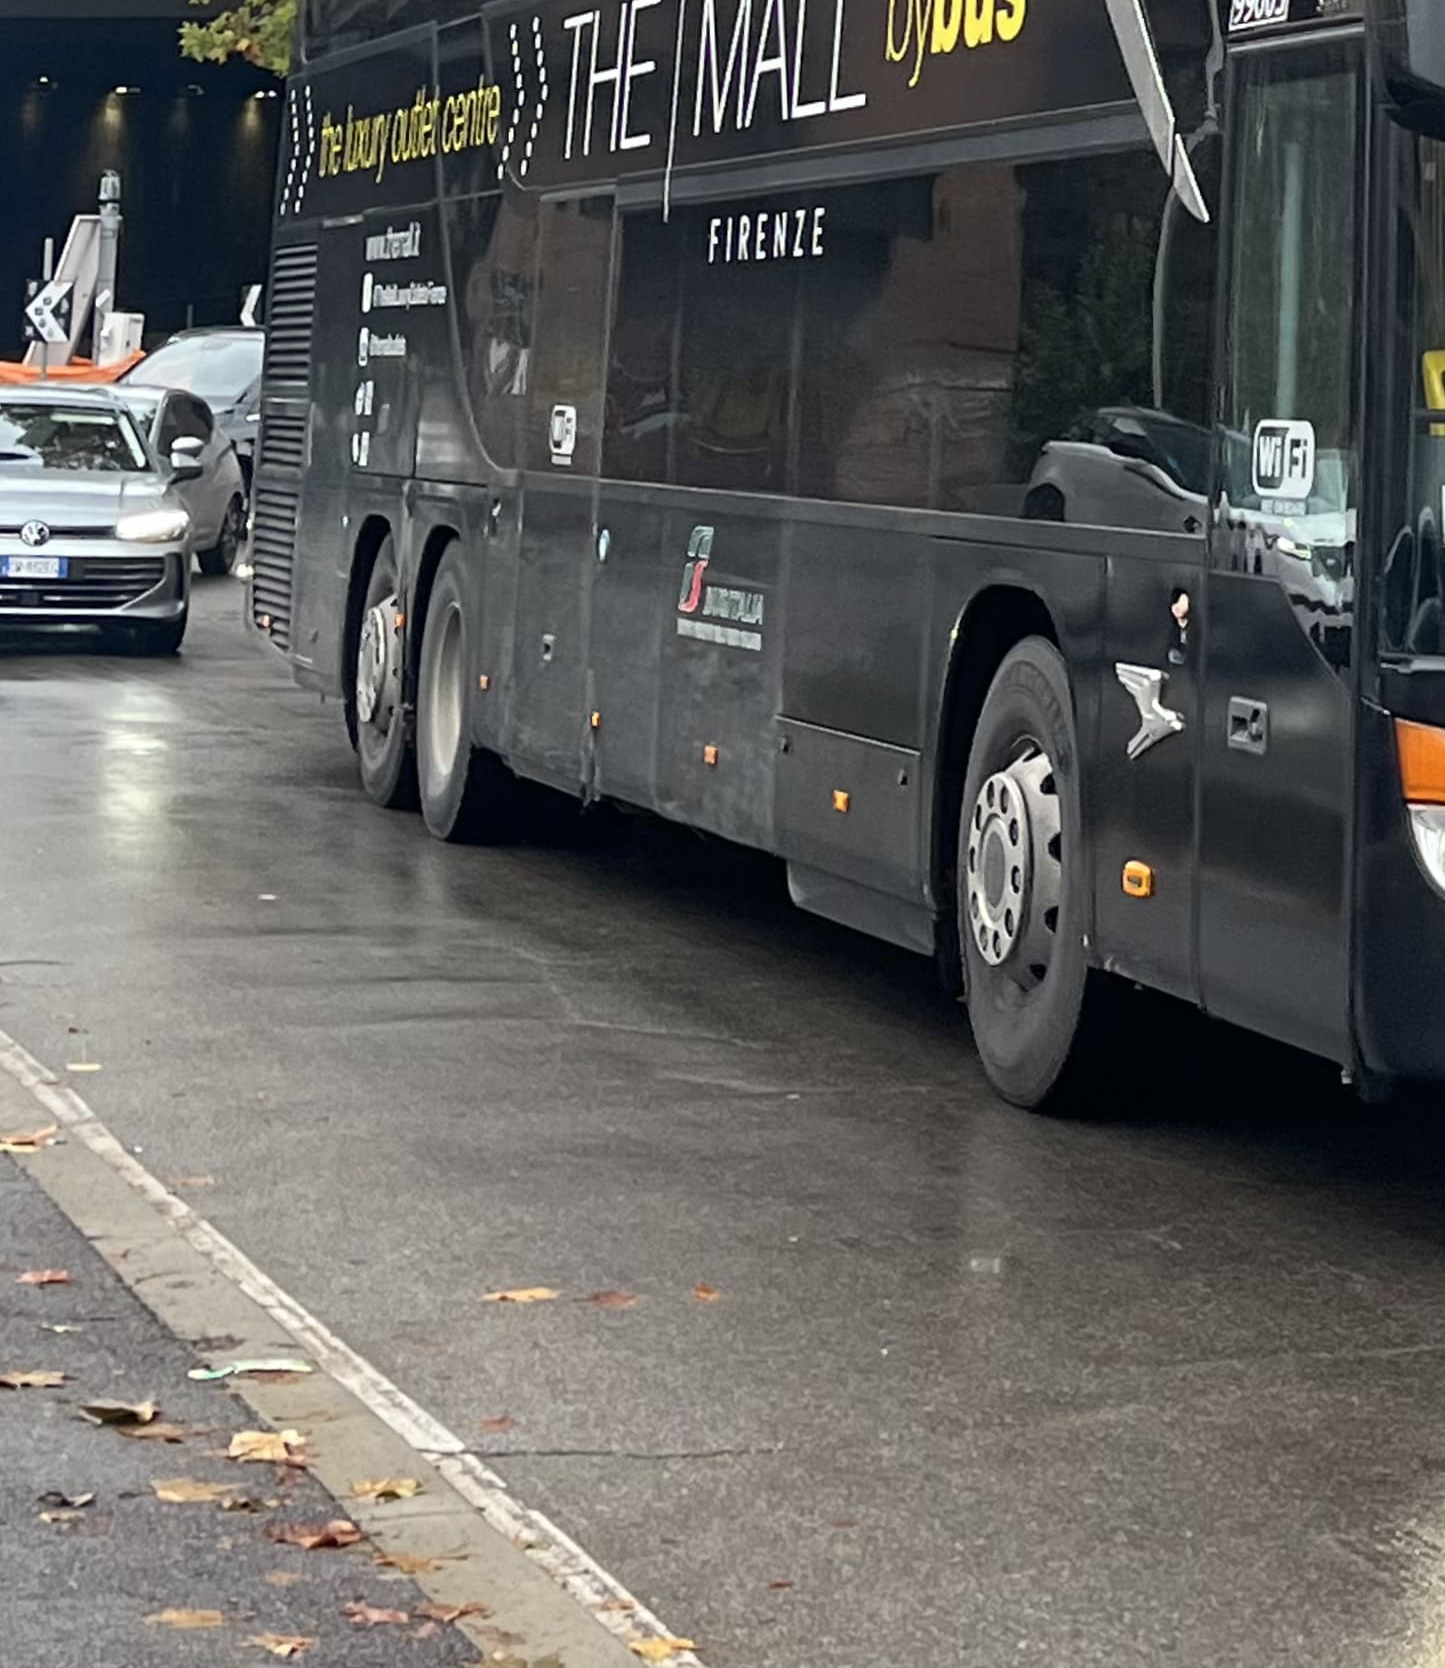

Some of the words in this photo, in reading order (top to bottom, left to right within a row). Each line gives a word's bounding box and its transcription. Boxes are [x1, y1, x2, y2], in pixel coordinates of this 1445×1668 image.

[319, 111, 343, 178] the
[343, 104, 392, 184] luxury
[391, 84, 441, 164] outlet
[441, 74, 501, 154] centre
[707, 206, 827, 264] FIRENZE
